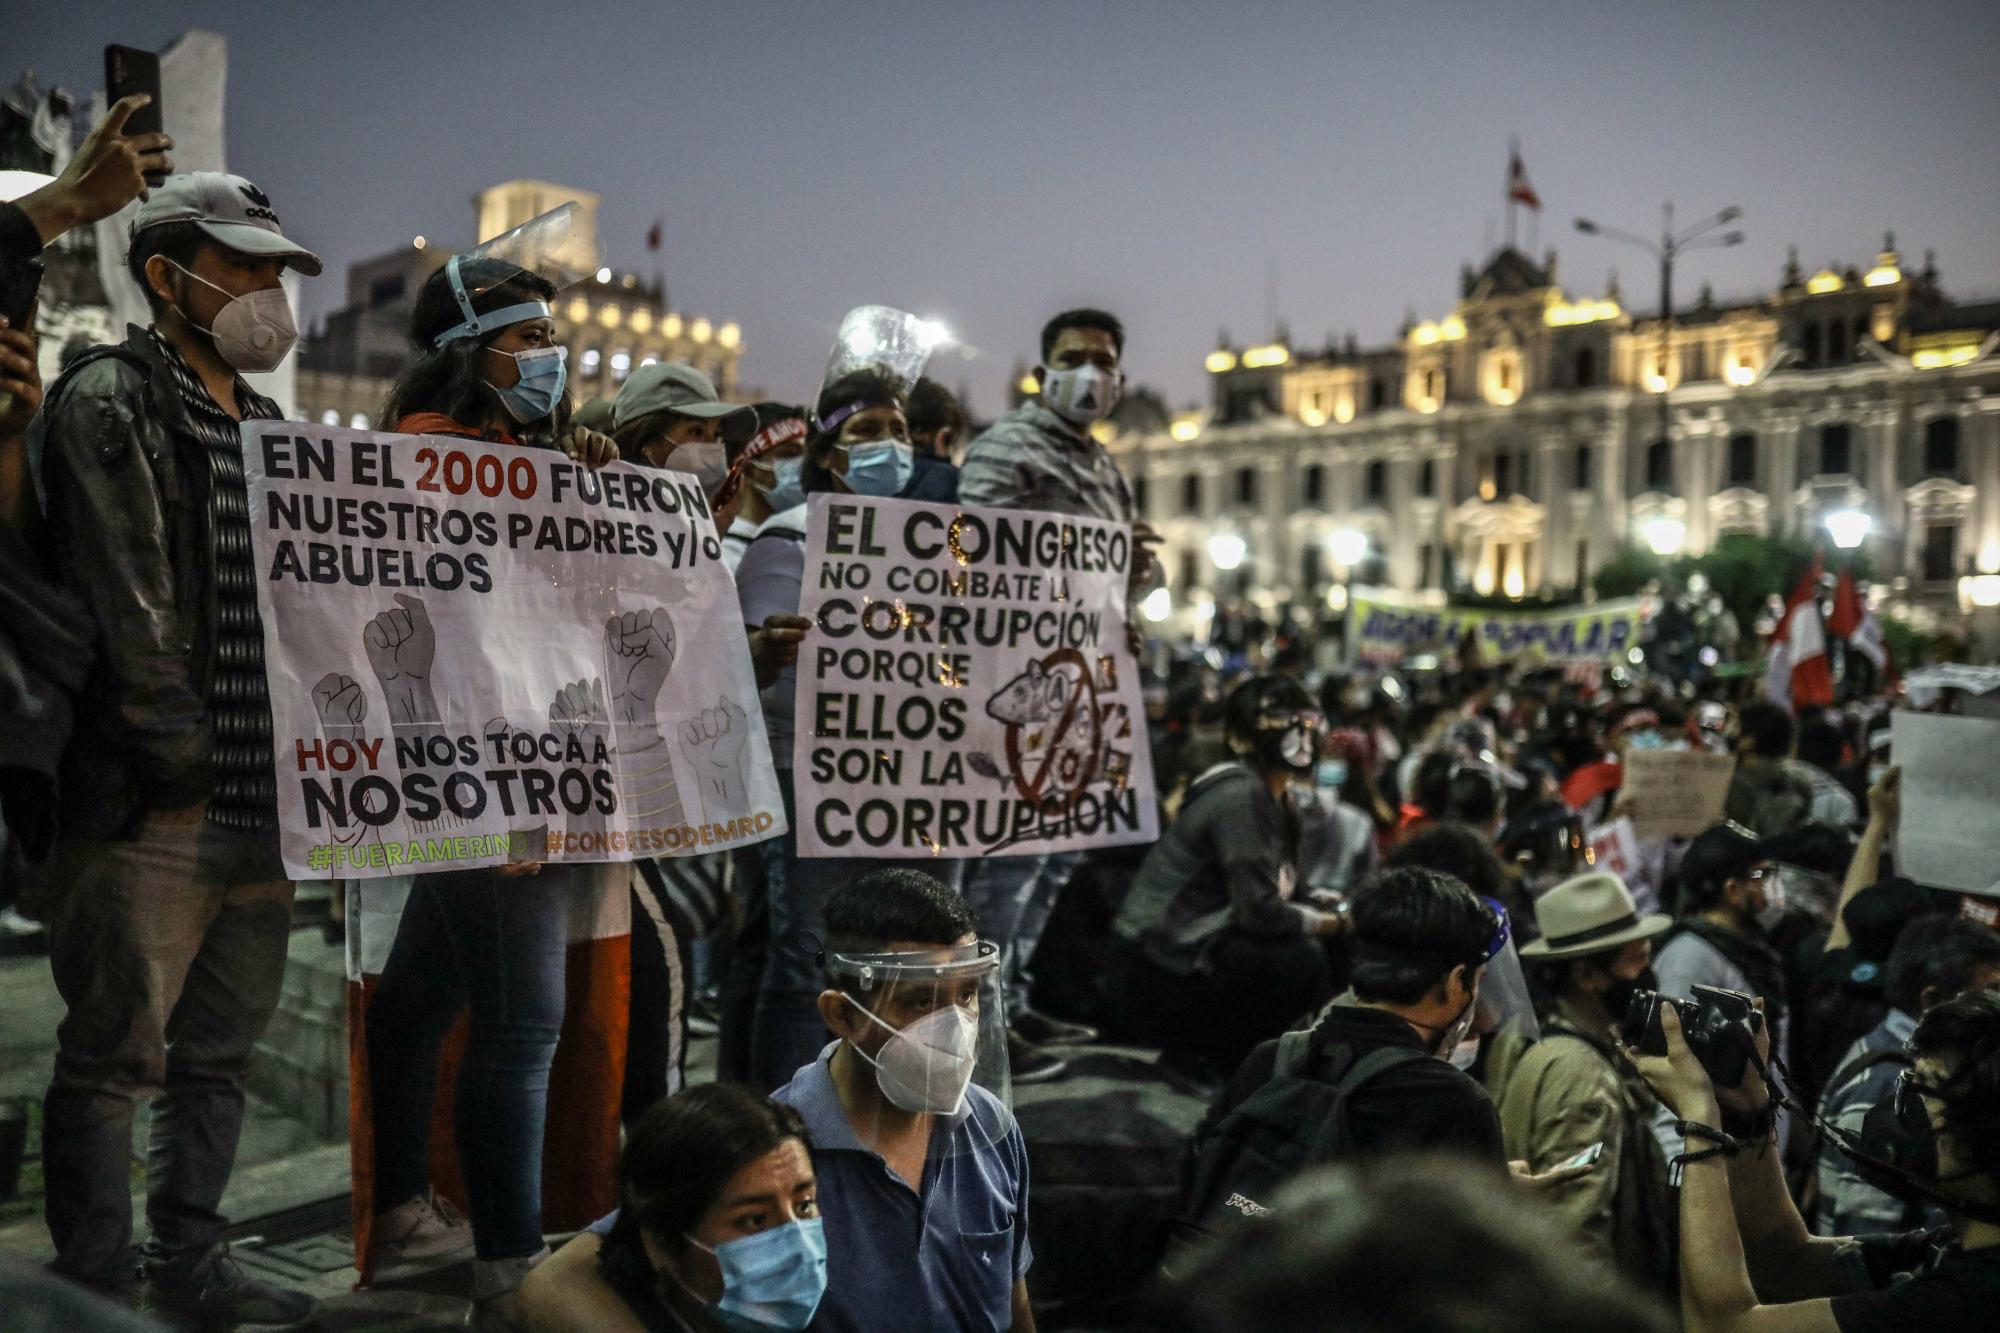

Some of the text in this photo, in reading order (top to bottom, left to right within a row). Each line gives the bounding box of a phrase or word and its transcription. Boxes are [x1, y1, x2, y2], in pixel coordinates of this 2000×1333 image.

[261, 435, 709, 520] EN EL 2000 FUERON
[267, 491, 498, 547] NUESTROS
[508, 514, 658, 557] PADRES
[825, 504, 1128, 573] EL CONGRESO
[269, 540, 492, 593] ABUELOS
[819, 562, 1070, 602] NO COMBATE LA
[817, 598, 1100, 648] CORRUPCIÓN
[816, 647, 971, 688] PORQUE
[815, 692, 967, 742] ELLOS
[296, 733, 611, 771] HOY NOS TOCA A
[811, 747, 966, 786] SON LA
[302, 768, 617, 828] NOSOTROS
[307, 812, 773, 870] #FUERAMERINO #CONGRESODEMRD
